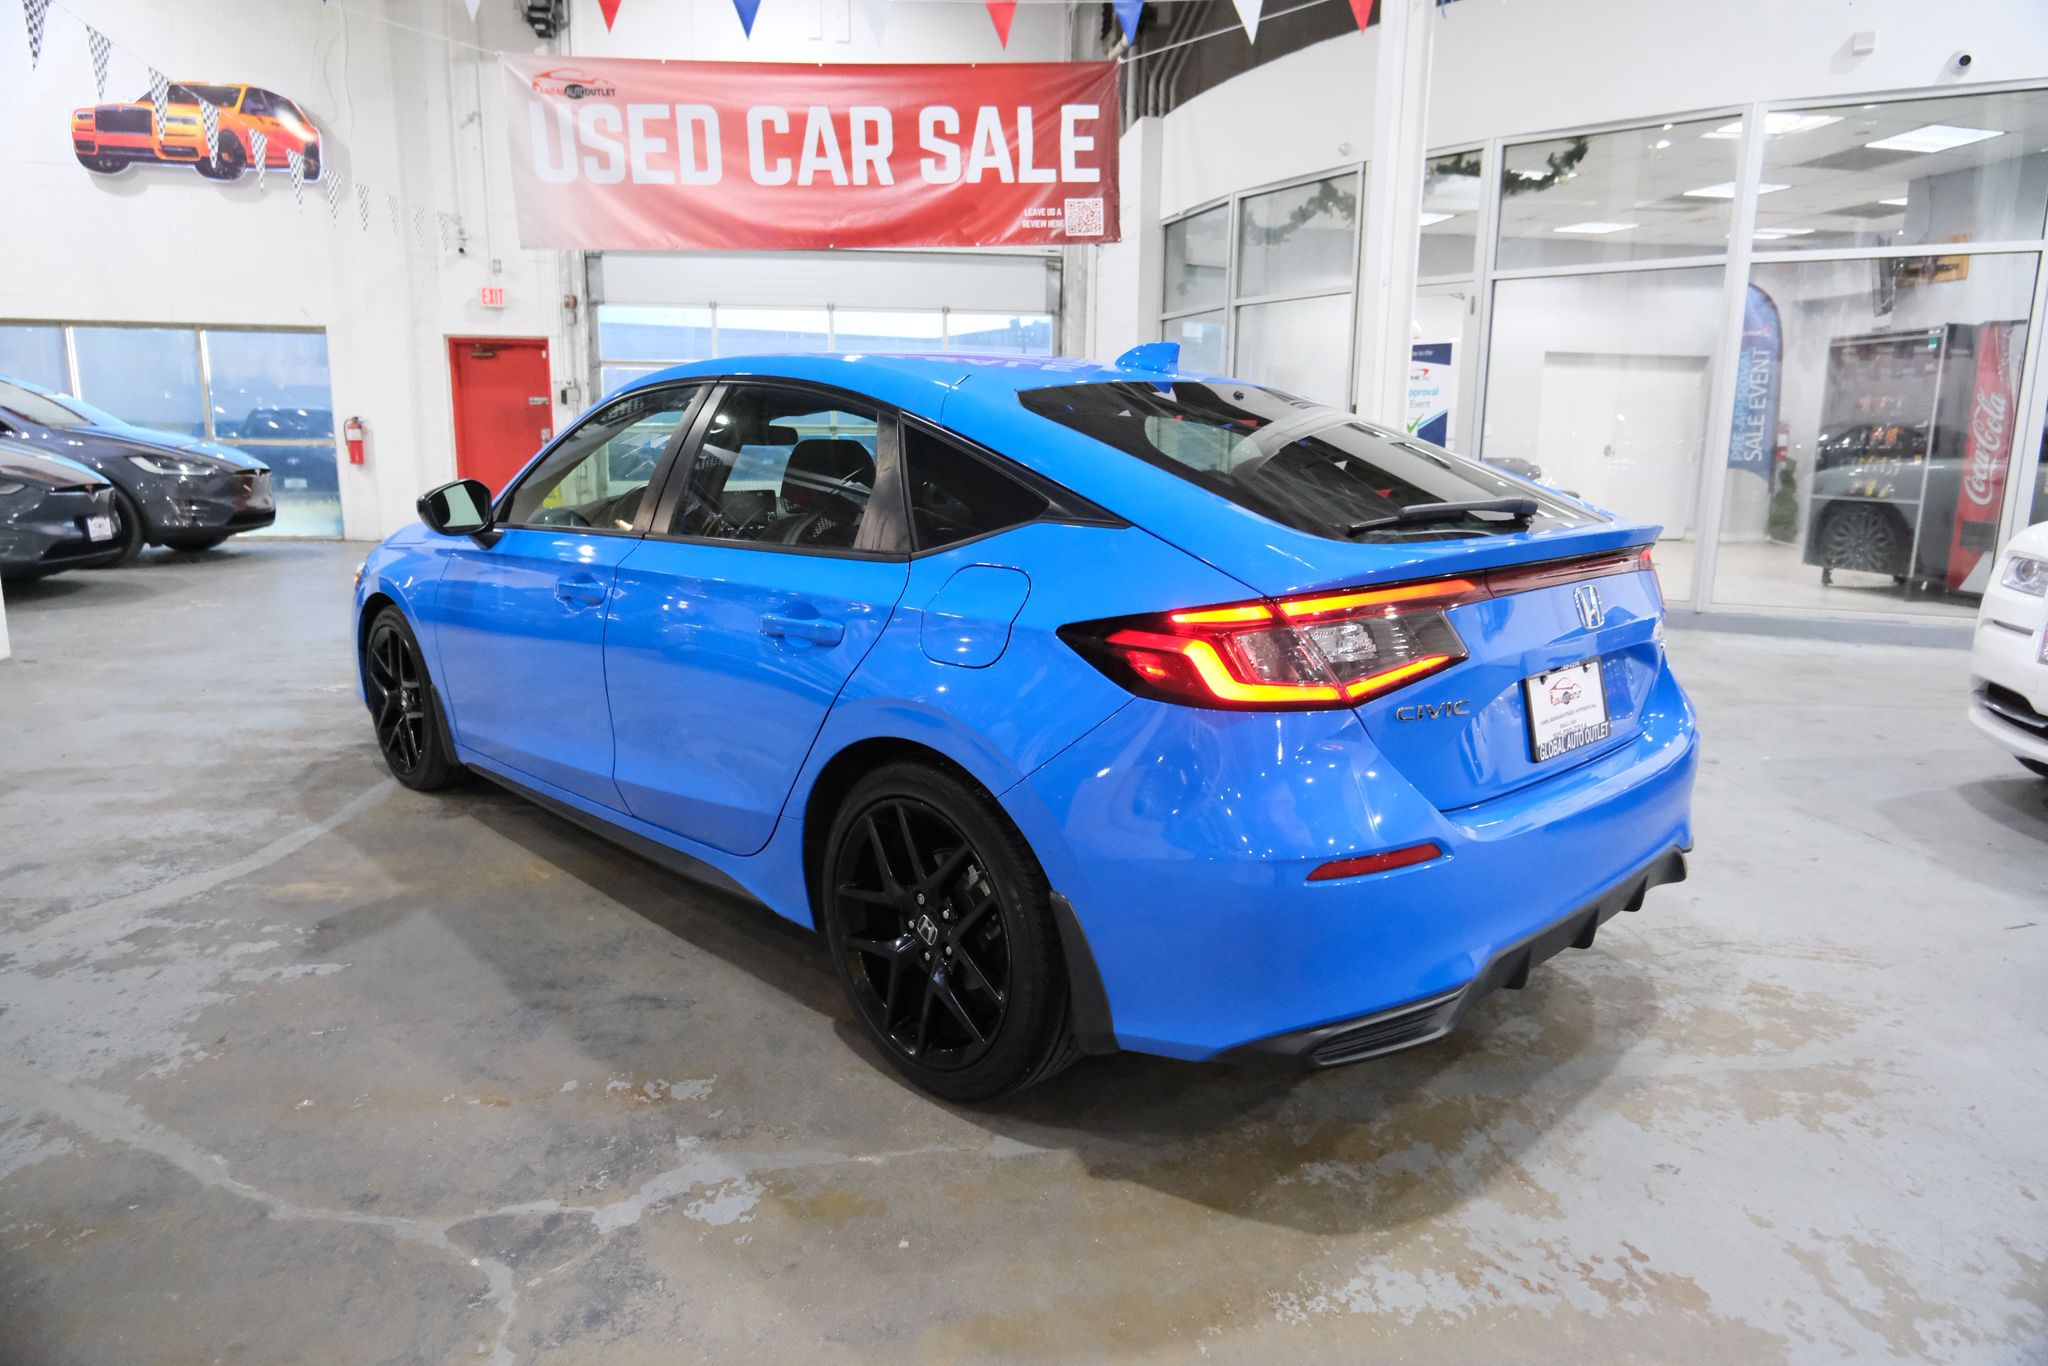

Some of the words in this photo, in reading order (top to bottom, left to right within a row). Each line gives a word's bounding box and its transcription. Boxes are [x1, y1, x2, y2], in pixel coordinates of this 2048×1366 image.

[528, 103, 722, 185] USED
[746, 105, 894, 186] CAR
[918, 104, 1100, 185] SALE
[1024, 208, 1046, 216] LEAVE
[1056, 208, 1062, 216] A
[1022, 219, 1047, 228] REVIEW
[481, 287, 504, 305] EXIT
[1748, 347, 1770, 409] EVENT
[1407, 387, 1440, 398] pproval
[1743, 413, 1766, 461] SALE
[1396, 699, 1471, 721] CIVIC
[1539, 738, 1567, 761] GLOBAL
[1566, 730, 1585, 750] AUTO
[1585, 721, 1609, 743] OUTLET
